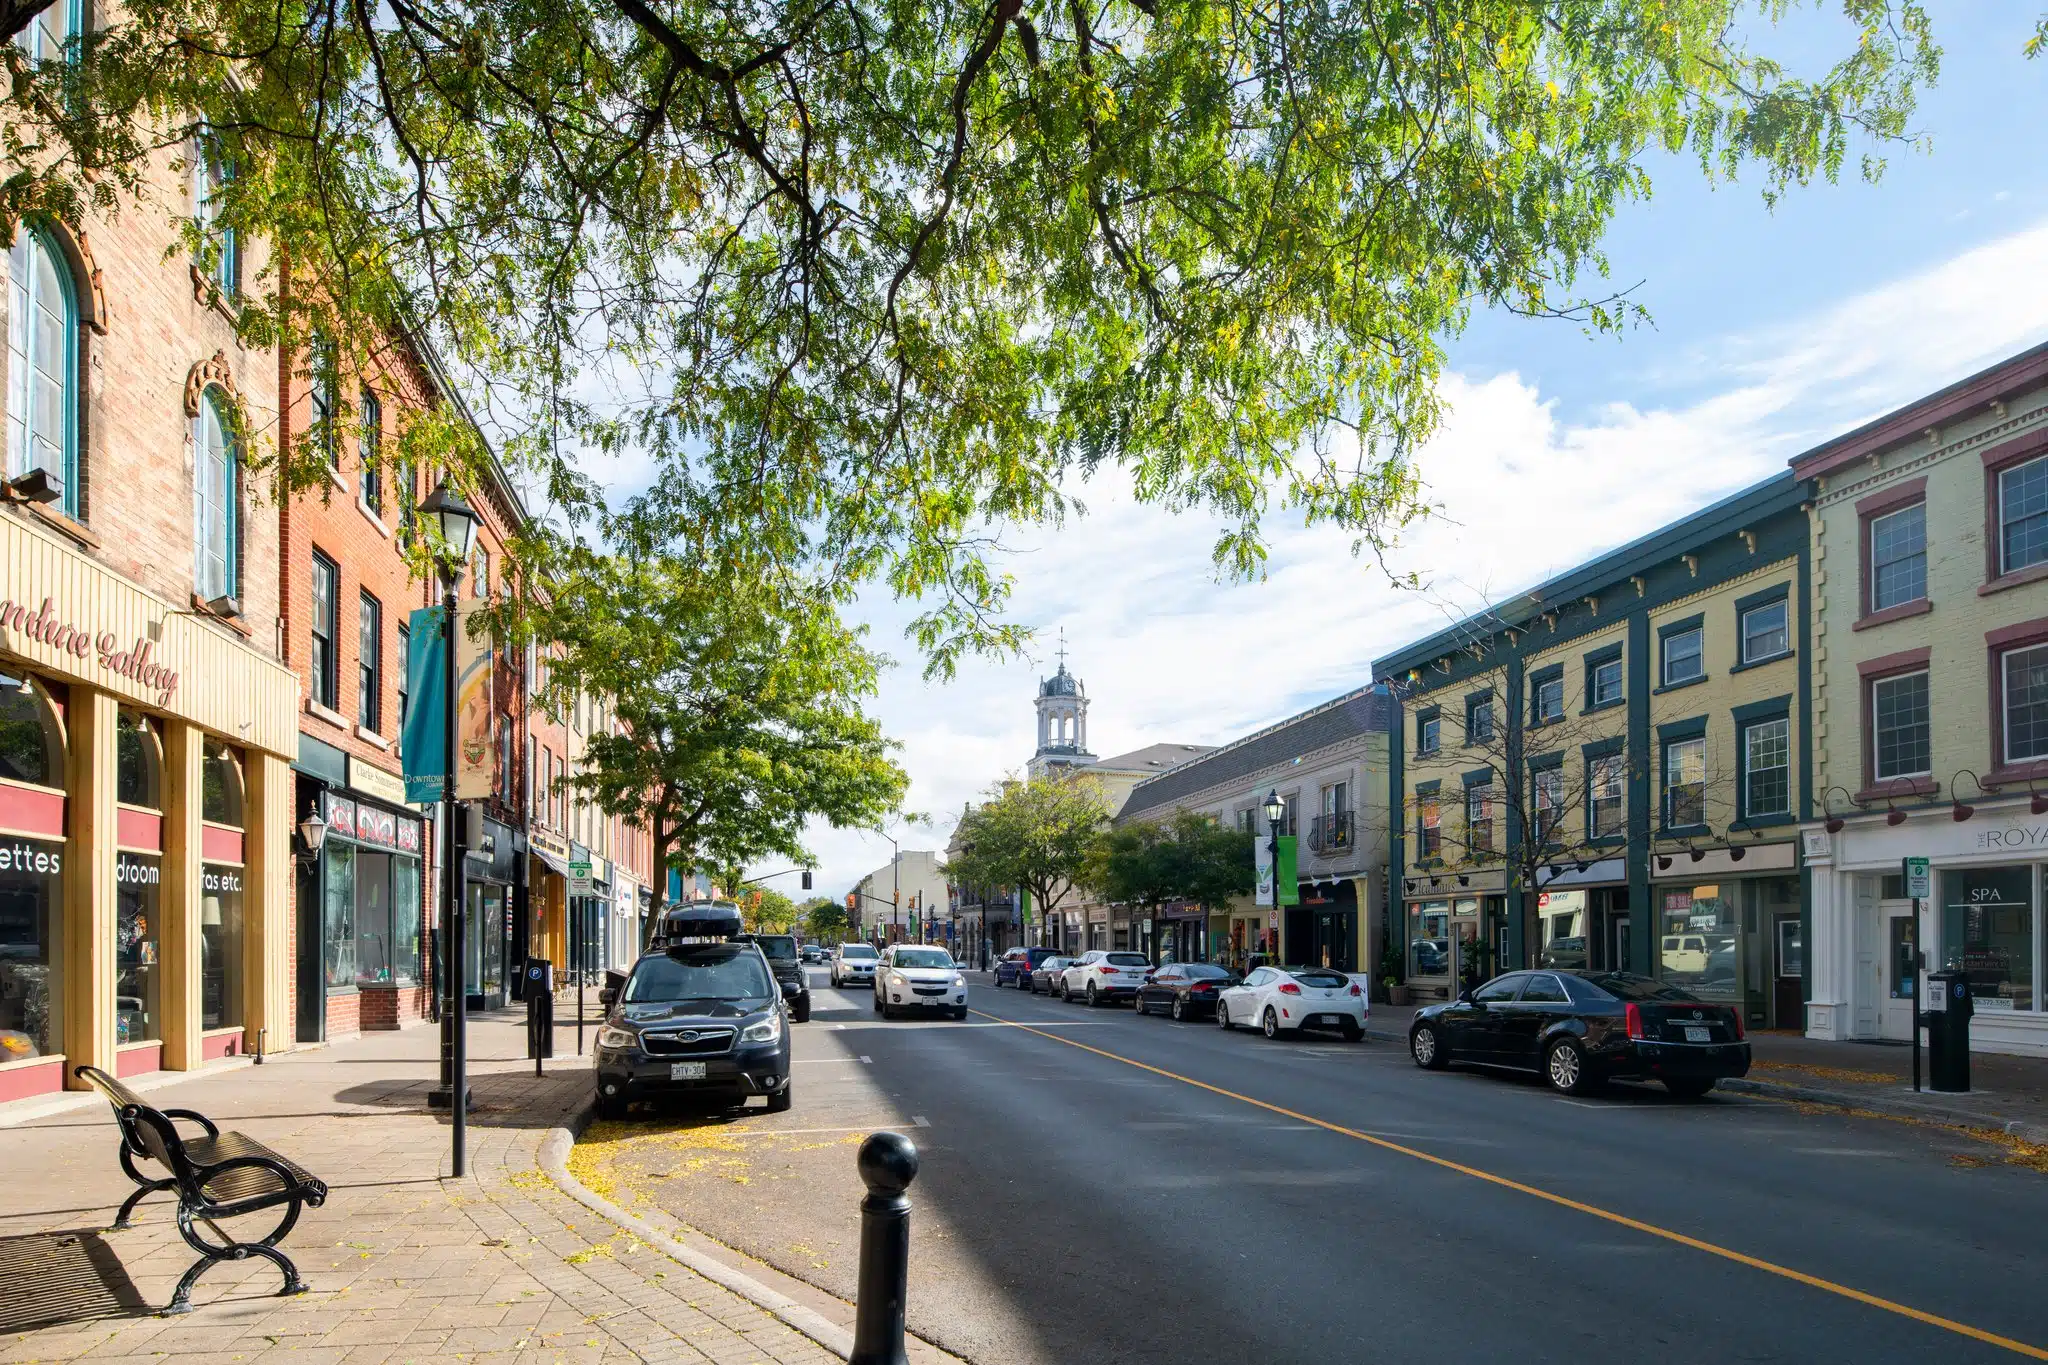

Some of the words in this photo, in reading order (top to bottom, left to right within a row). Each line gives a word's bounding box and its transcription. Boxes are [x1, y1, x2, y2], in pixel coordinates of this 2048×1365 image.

[96, 629, 179, 708] Gallery
[1978, 831, 1986, 848] THE
[0, 843, 60, 874] ettes
[222, 876, 242, 892] etc.
[1971, 888, 2001, 901] SPA
